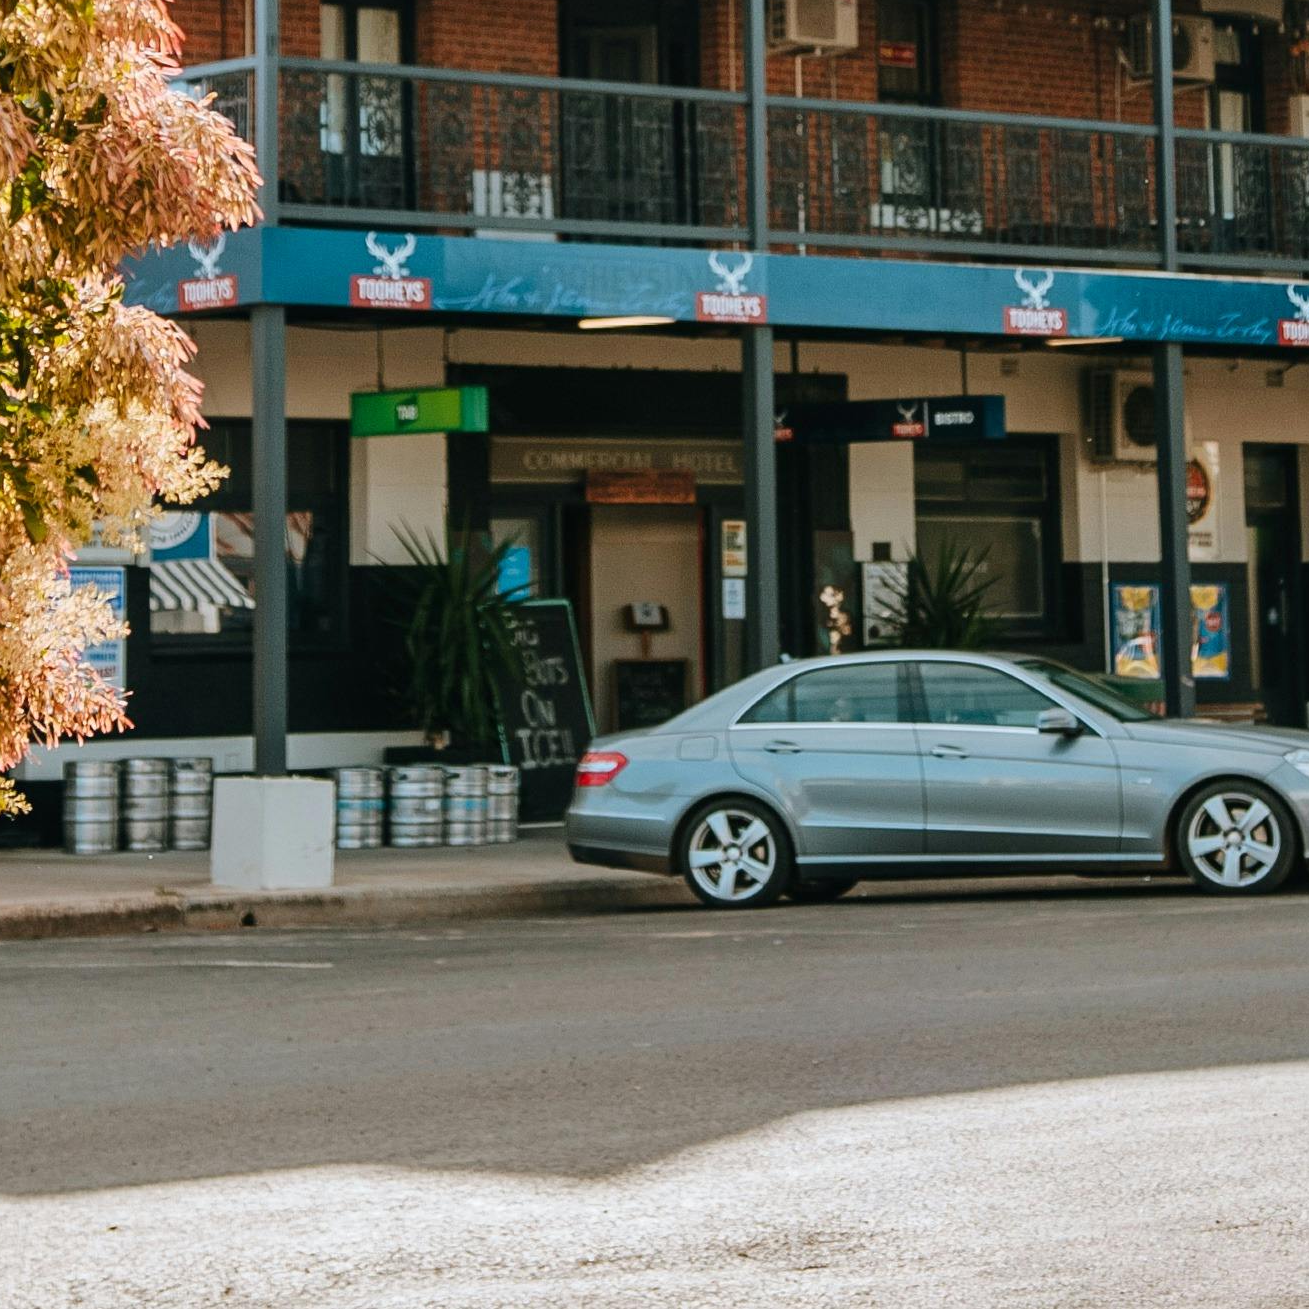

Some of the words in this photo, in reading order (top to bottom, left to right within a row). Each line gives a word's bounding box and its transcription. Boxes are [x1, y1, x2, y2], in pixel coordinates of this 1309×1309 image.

[182, 277, 235, 304] TOOHEYS
[357, 277, 425, 303] TOOHEYS
[700, 293, 761, 318] TOOHEYS
[1009, 308, 1063, 330] TOOHEYS
[934, 411, 975, 426] BISTRO
[522, 450, 652, 471] COMMERCIAL
[672, 451, 738, 473] HOTEL
